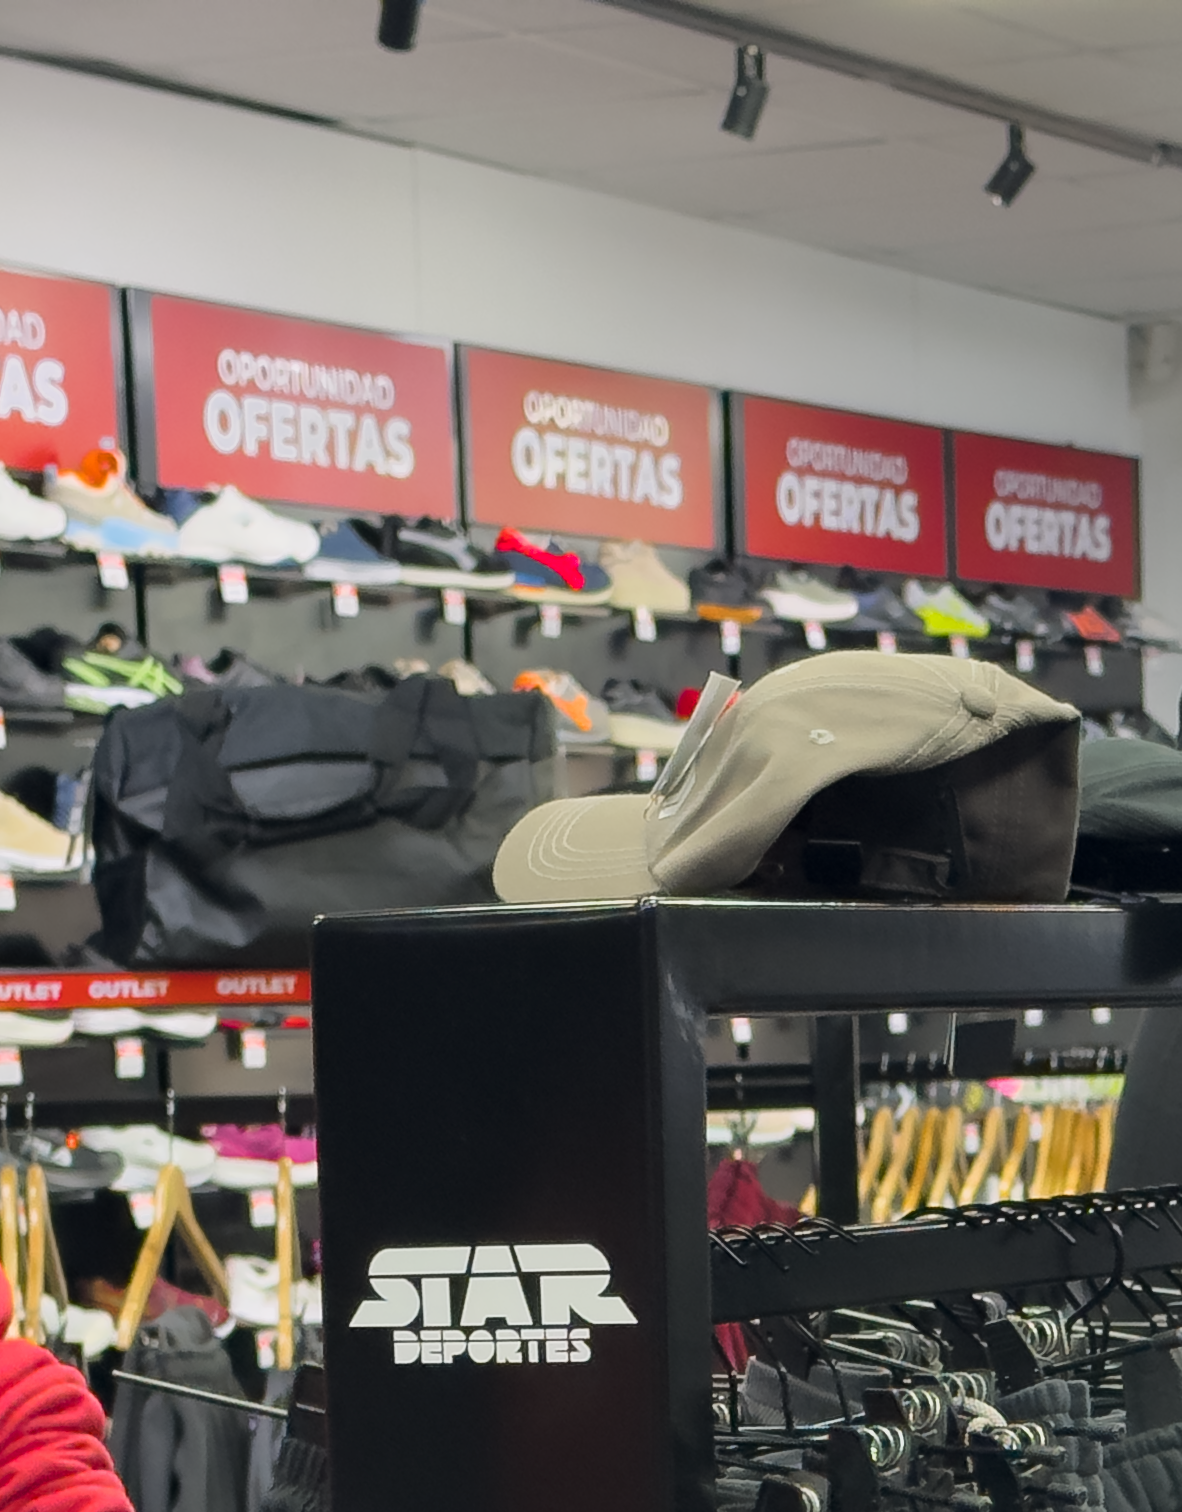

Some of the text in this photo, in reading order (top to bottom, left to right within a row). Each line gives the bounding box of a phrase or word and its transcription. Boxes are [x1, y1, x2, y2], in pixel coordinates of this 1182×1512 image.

[217, 348, 395, 410] OPORTUNIDAD
[203, 388, 415, 480] OFERTAS
[523, 390, 670, 447] OPORTUNIDAD
[511, 426, 684, 510] OFERTAS
[775, 470, 921, 543] OFERTAS
[984, 500, 1113, 563] OFERTAS
[88, 979, 169, 999] OUTLET
[216, 974, 296, 996] OUTLET
[348, 1243, 639, 1328] STAR
[392, 1327, 592, 1365] DEPORTES
